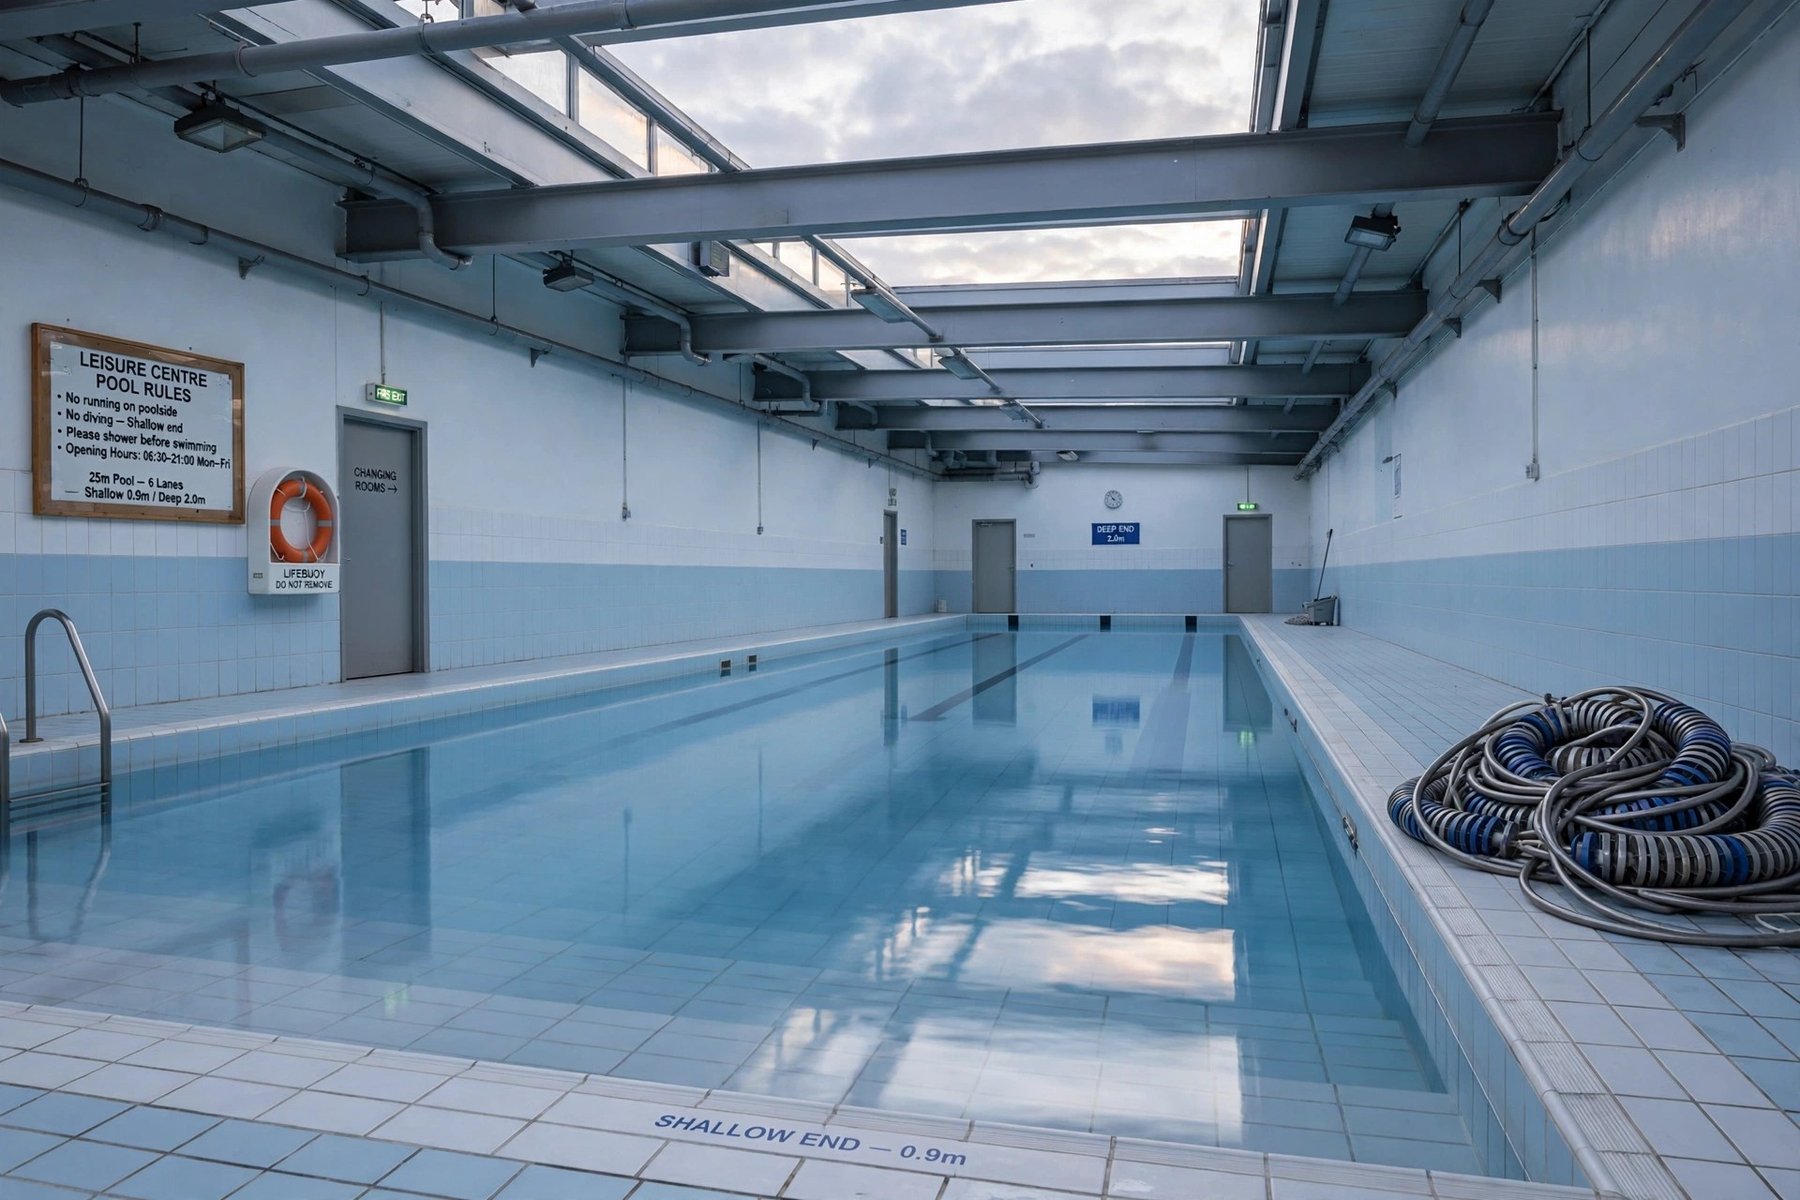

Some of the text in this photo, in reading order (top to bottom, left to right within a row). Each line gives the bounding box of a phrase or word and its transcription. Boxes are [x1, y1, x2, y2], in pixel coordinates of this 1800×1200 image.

[80, 351, 208, 388] LEISURE CENTRE
[96, 374, 192, 403] POOL RULES
[66, 392, 178, 417] No running on poolside
[66, 408, 80, 421] No
[83, 411, 113, 427] diving
[127, 416, 164, 431] Shallow
[167, 423, 183, 433] end
[66, 426, 217, 455] Please shower before swimming
[66, 442, 107, 460] Opening
[110, 446, 141, 460] Hours:
[89, 471, 110, 484] 25m
[113, 473, 134, 486] Pool
[148, 477, 154, 488] 6
[156, 477, 184, 490] Lanes
[354, 467, 397, 493] CHANGING ROOMS
[84, 486, 124, 499] Shallow
[127, 489, 150, 501] 0.9m
[158, 491, 182, 506] Deep
[184, 493, 206, 505] 2.0m
[1096, 525, 1135, 533] DEEP END
[1107, 534, 1125, 543] 2.0m
[275, 580, 333, 589] DO NOT REMOVE
[283, 569, 326, 579] LIFEBUOY
[654, 1114, 796, 1144] SHALLOW
[798, 1132, 861, 1152] END
[899, 1144, 967, 1166] 0.9m
